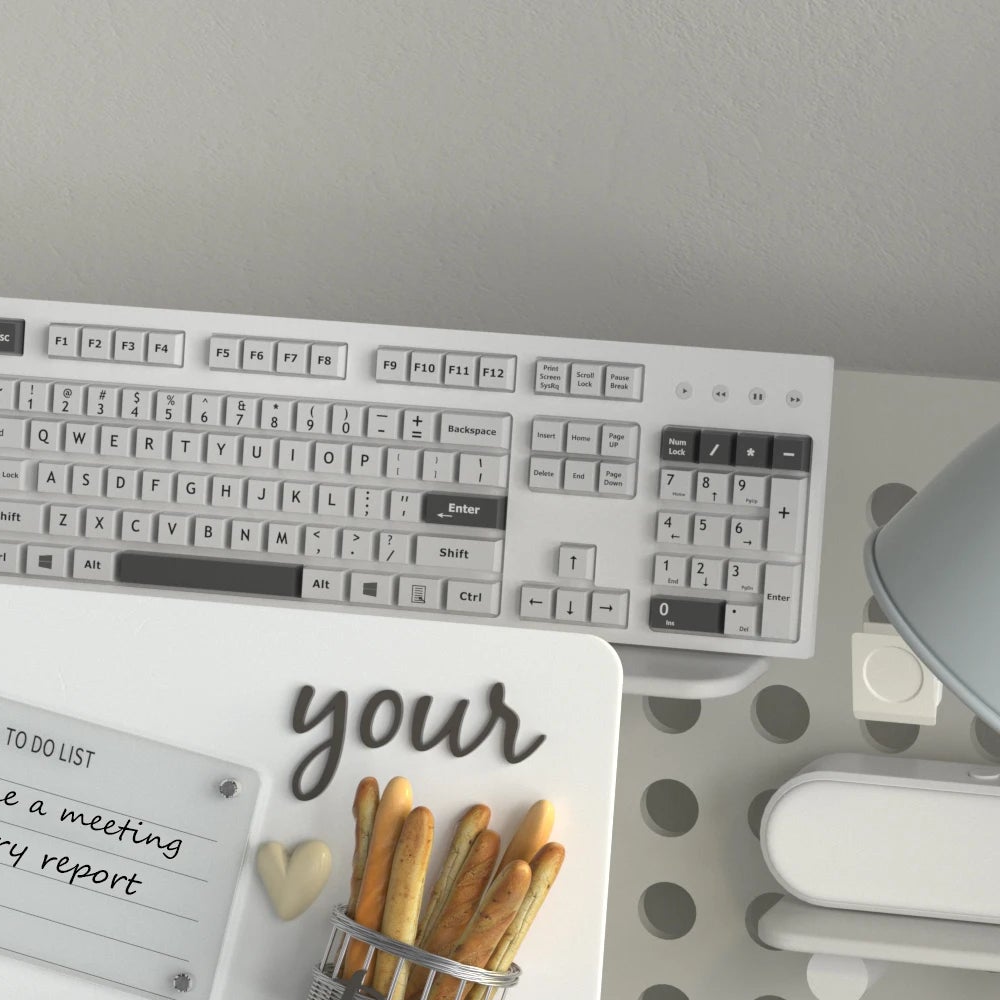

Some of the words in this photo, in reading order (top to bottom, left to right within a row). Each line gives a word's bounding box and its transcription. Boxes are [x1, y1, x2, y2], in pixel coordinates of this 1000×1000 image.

[56, 337, 67, 345] F1
[89, 339, 101, 348] F2
[122, 342, 134, 350] F3
[155, 344, 168, 353] F4
[217, 349, 229, 357] F5
[250, 351, 263, 360] F6
[284, 353, 297, 362] F7
[318, 356, 331, 365] F8
[384, 361, 396, 370] F9
[415, 363, 435, 373] F10
[449, 366, 469, 375] F11
[483, 368, 503, 378] F12
[63, 389, 72, 398] @
[100, 390, 106, 400] #
[134, 392, 139, 404] $
[62, 401, 68, 412] 2
[97, 403, 103, 414] 3
[131, 407, 138, 417] 4
[165, 409, 172, 420] 5
[201, 412, 208, 422] 6
[237, 414, 243, 425] 7
[271, 417, 278, 428] 8
[307, 420, 314, 430] 9
[342, 422, 350, 433] 0
[449, 425, 496, 436] Backspace
[39, 429, 49, 444] Q
[73, 432, 86, 444] W
[111, 435, 118, 447] E
[609, 433, 624, 441] Page
[145, 437, 153, 450] R
[181, 440, 190, 452] T
[217, 443, 226, 455] Y
[253, 446, 261, 458] U
[324, 452, 334, 464] O
[361, 454, 369, 466] P
[0, 471, 19, 479] Lock
[47, 471, 56, 483] A
[83, 474, 89, 486] S
[667, 474, 674, 485] 7
[117, 476, 125, 488] D
[152, 479, 160, 491] F
[703, 477, 709, 488] 8
[739, 480, 745, 491] 9
[186, 482, 195, 494] G
[222, 485, 230, 497] H
[258, 488, 265, 500] J
[292, 490, 300, 503] K
[328, 493, 336, 506] L
[448, 503, 480, 515] Enter
[59, 514, 67, 526] Z
[95, 517, 104, 529] X
[664, 517, 671, 527] 4
[700, 519, 706, 530] 5
[131, 520, 139, 532] C
[168, 523, 177, 535] V
[736, 523, 742, 533] 6
[205, 526, 212, 538] B
[241, 529, 250, 541] N
[276, 532, 287, 544] M
[440, 548, 468, 559] Shift
[84, 560, 100, 569] Alt
[697, 563, 704, 574] 2
[733, 565, 739, 576] 3
[313, 580, 329, 589] Alt
[460, 592, 481, 601] Ctrl
[660, 603, 668, 616] 0
[292, 682, 546, 801] your
[6, 728, 27, 749] TO
[32, 735, 55, 758] DO
[59, 744, 96, 768] LIST
[29, 800, 47, 816] a
[60, 807, 182, 860] meeting
[41, 853, 142, 895] report
